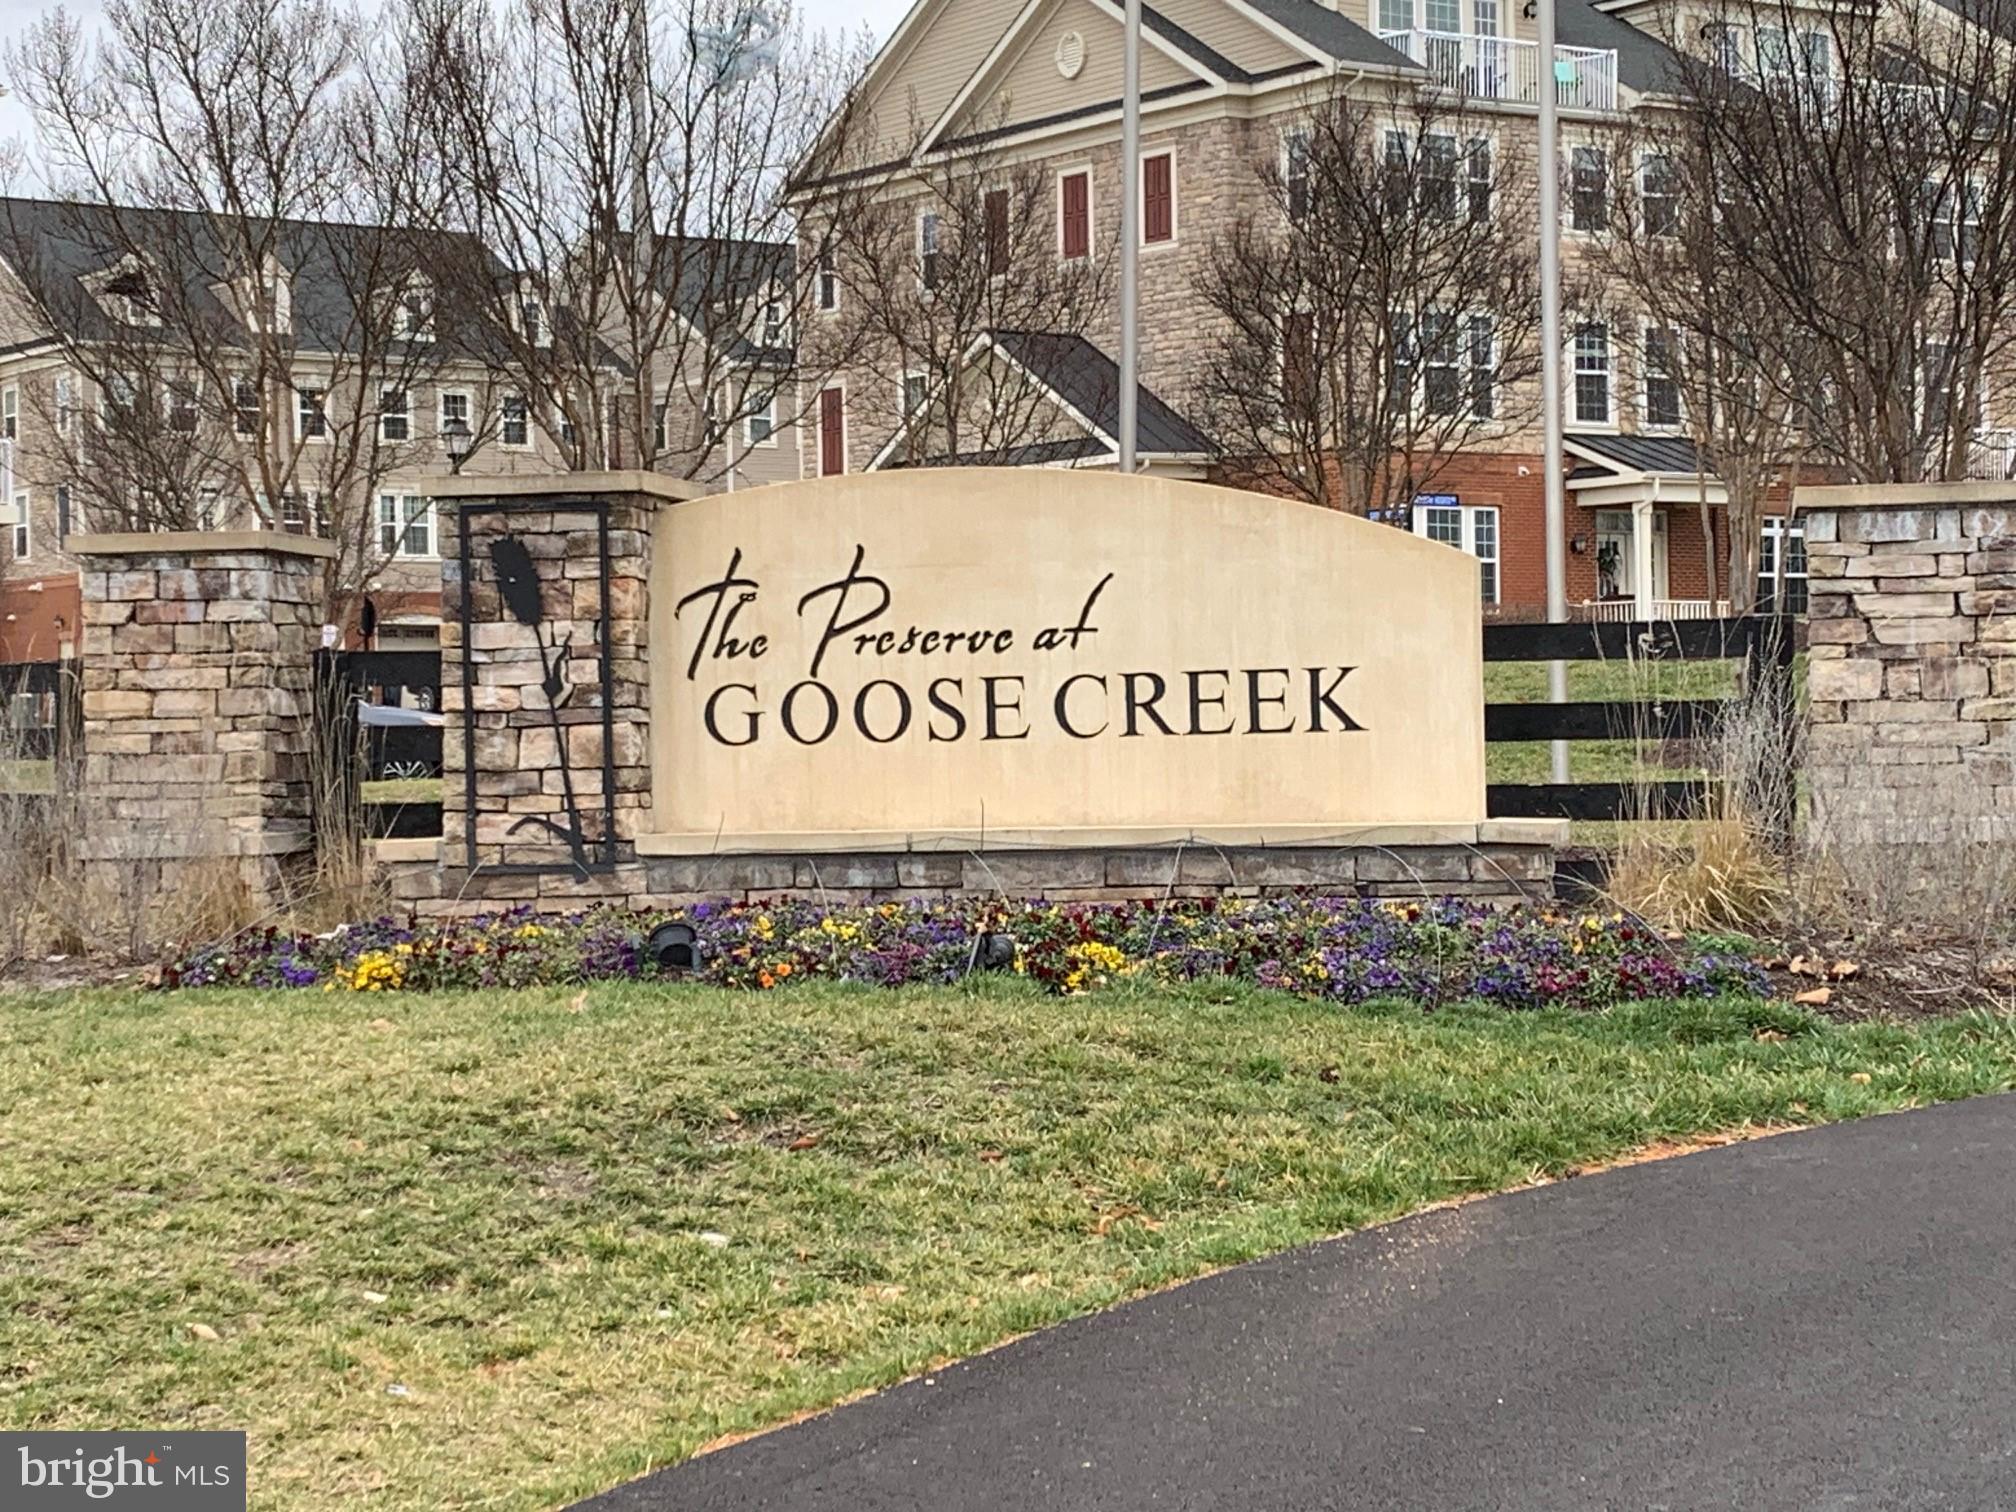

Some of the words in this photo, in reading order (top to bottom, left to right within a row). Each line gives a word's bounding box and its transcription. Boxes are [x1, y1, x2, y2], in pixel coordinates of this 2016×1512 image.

[674, 547, 768, 681] The
[797, 543, 1013, 680] Preserve
[1032, 572, 1114, 652] at
[704, 675, 1031, 747] GOOSE
[1053, 666, 1369, 739] CREEK
